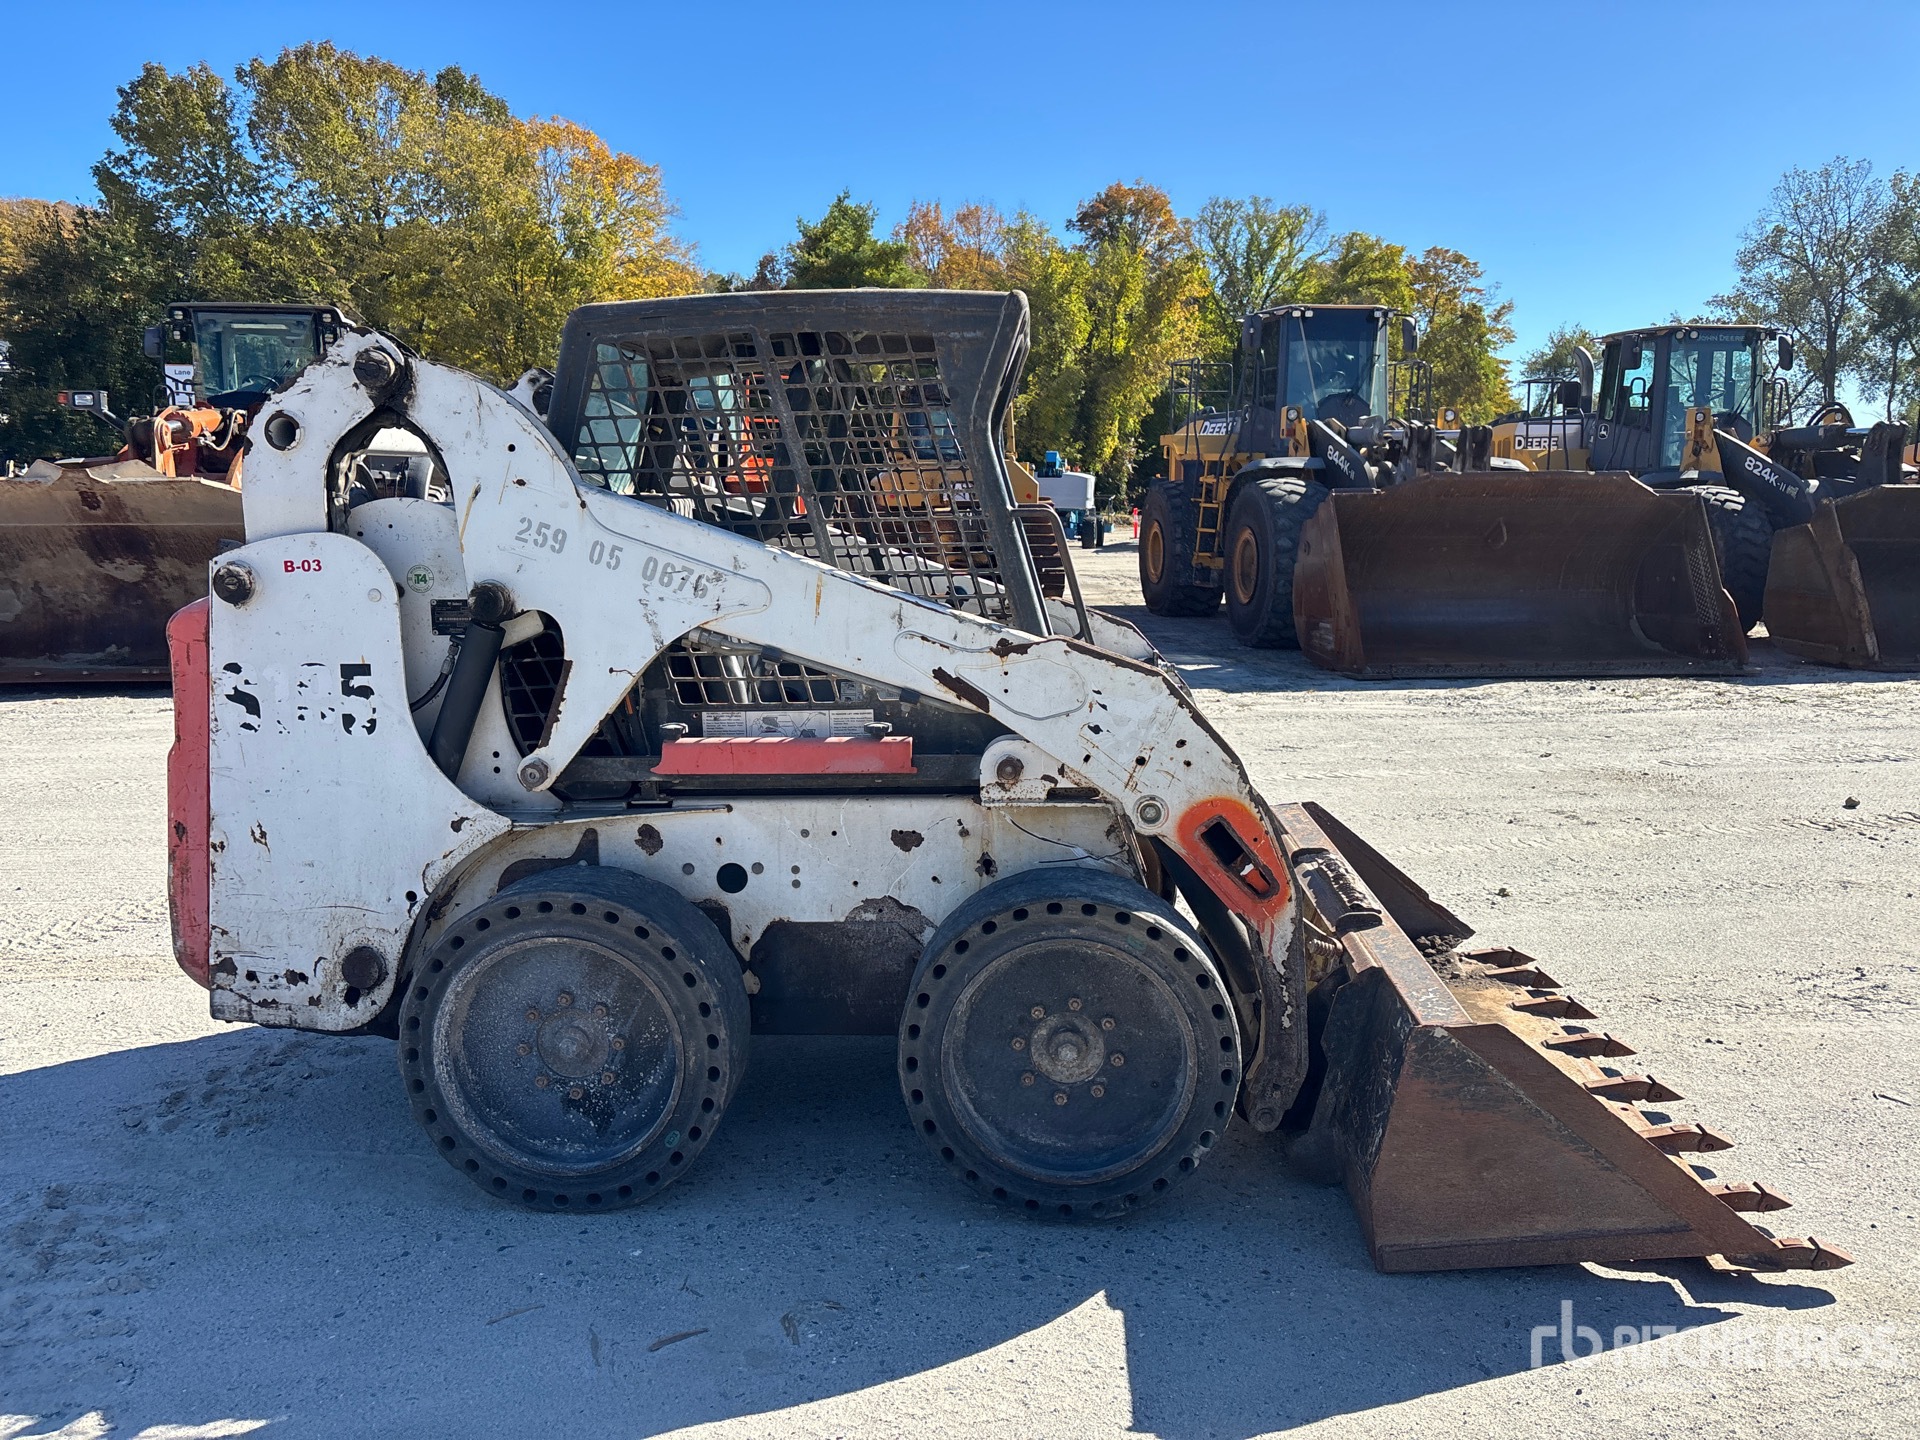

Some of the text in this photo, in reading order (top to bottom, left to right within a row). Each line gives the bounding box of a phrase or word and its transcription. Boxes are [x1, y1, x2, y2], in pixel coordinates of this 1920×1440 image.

[1514, 435, 1558, 451] DEERE
[514, 516, 568, 554] 259
[588, 540, 624, 571] 05
[283, 559, 322, 574] B-03
